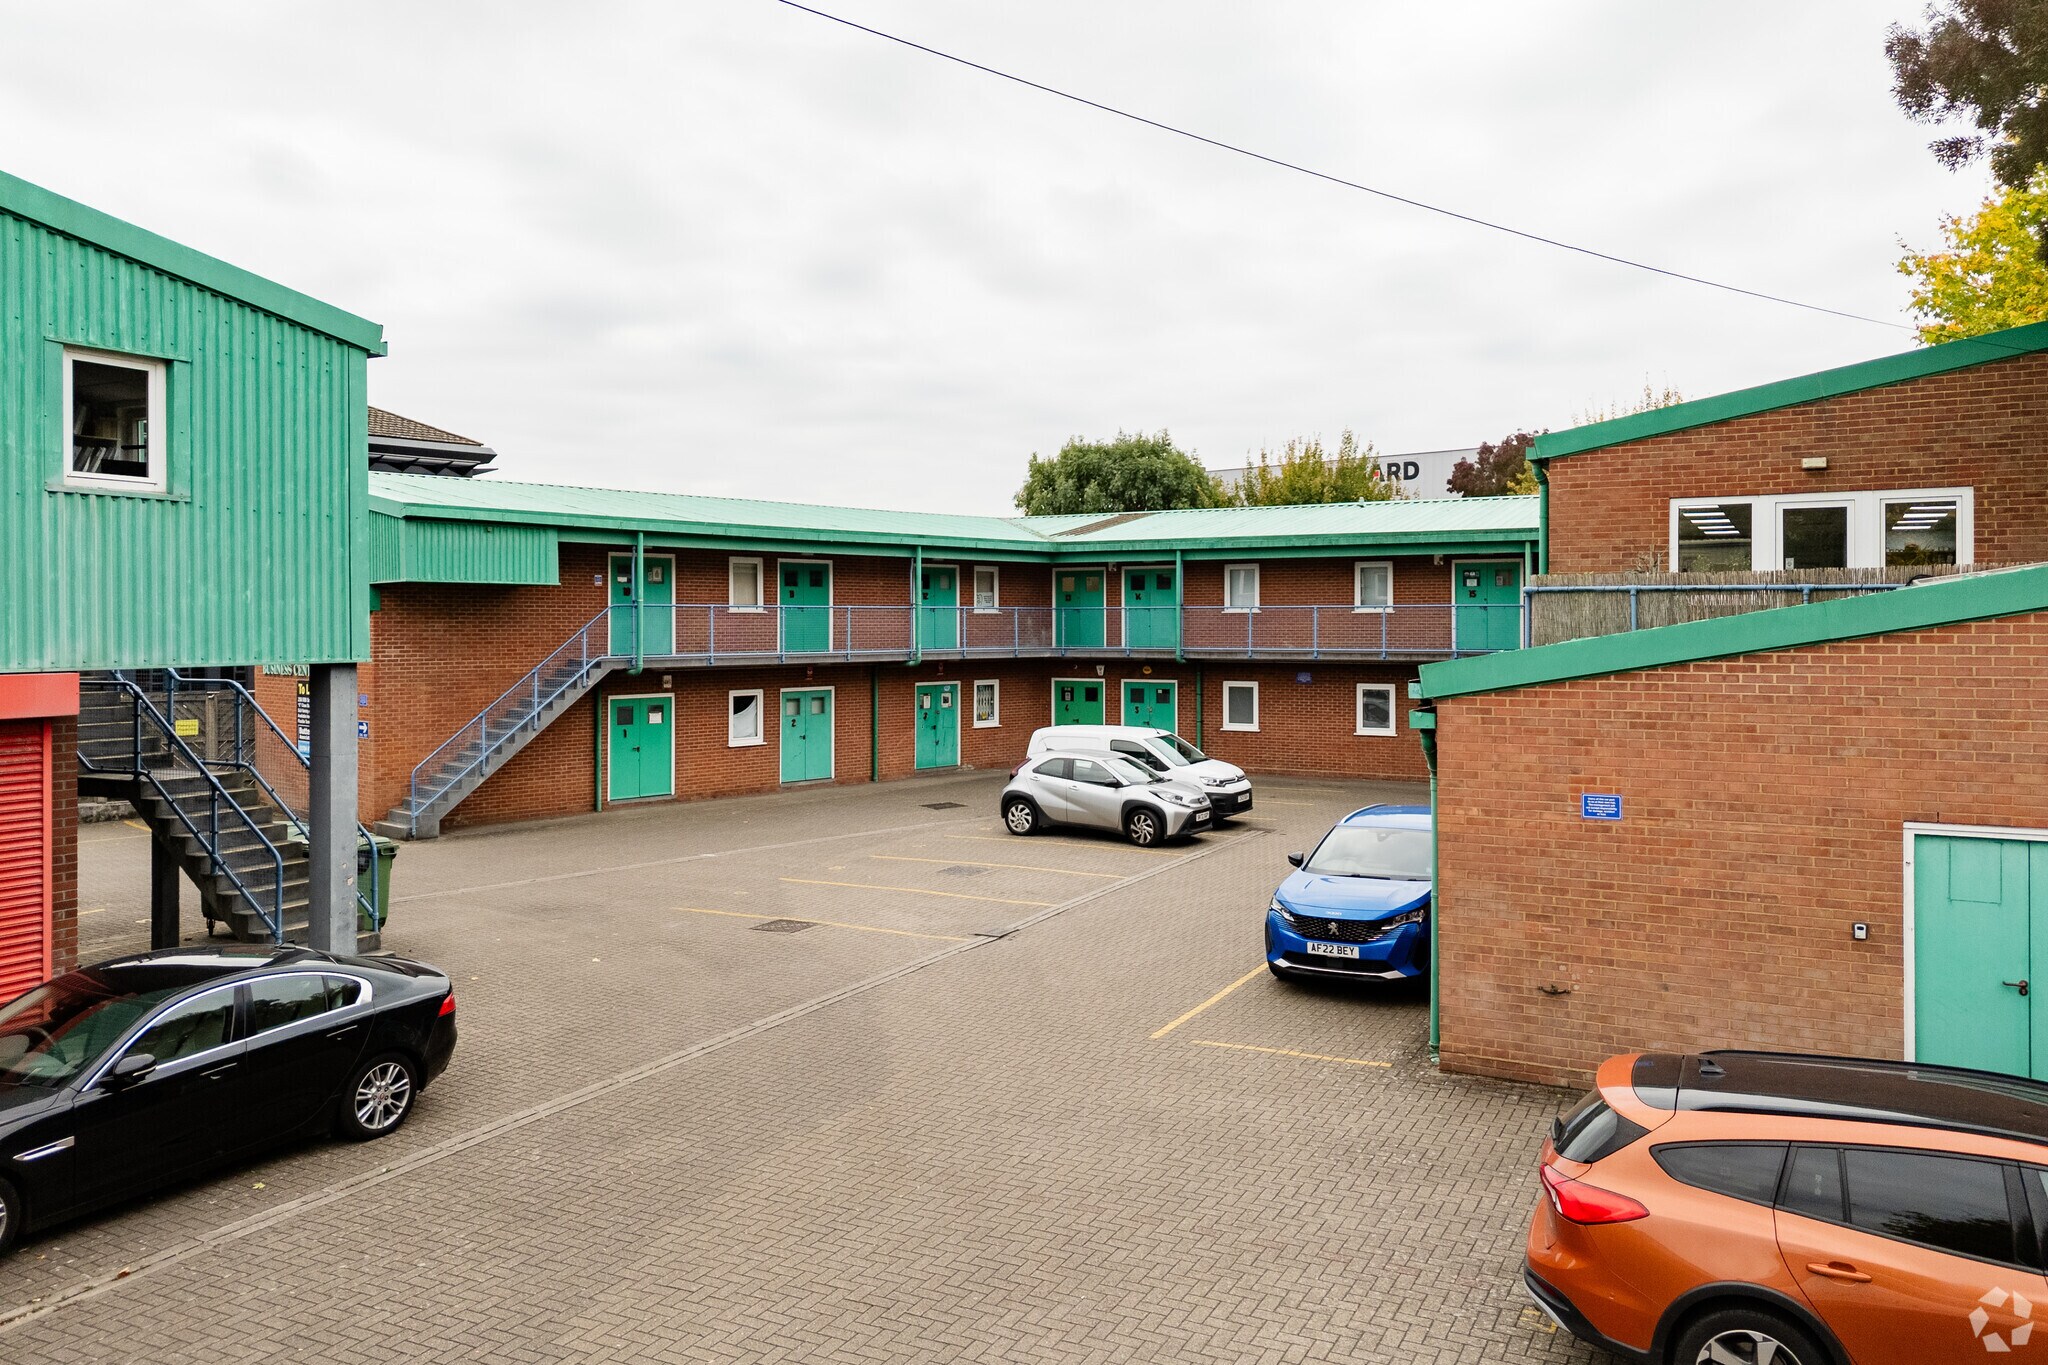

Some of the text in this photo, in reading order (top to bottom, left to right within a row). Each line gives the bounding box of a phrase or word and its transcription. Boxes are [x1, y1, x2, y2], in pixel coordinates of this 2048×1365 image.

[262, 664, 292, 676] BUSINESS
[298, 683, 305, 695] To
[791, 719, 796, 728] 2
[623, 729, 627, 738] 1
[1311, 943, 1354, 956] AF22 BEY
